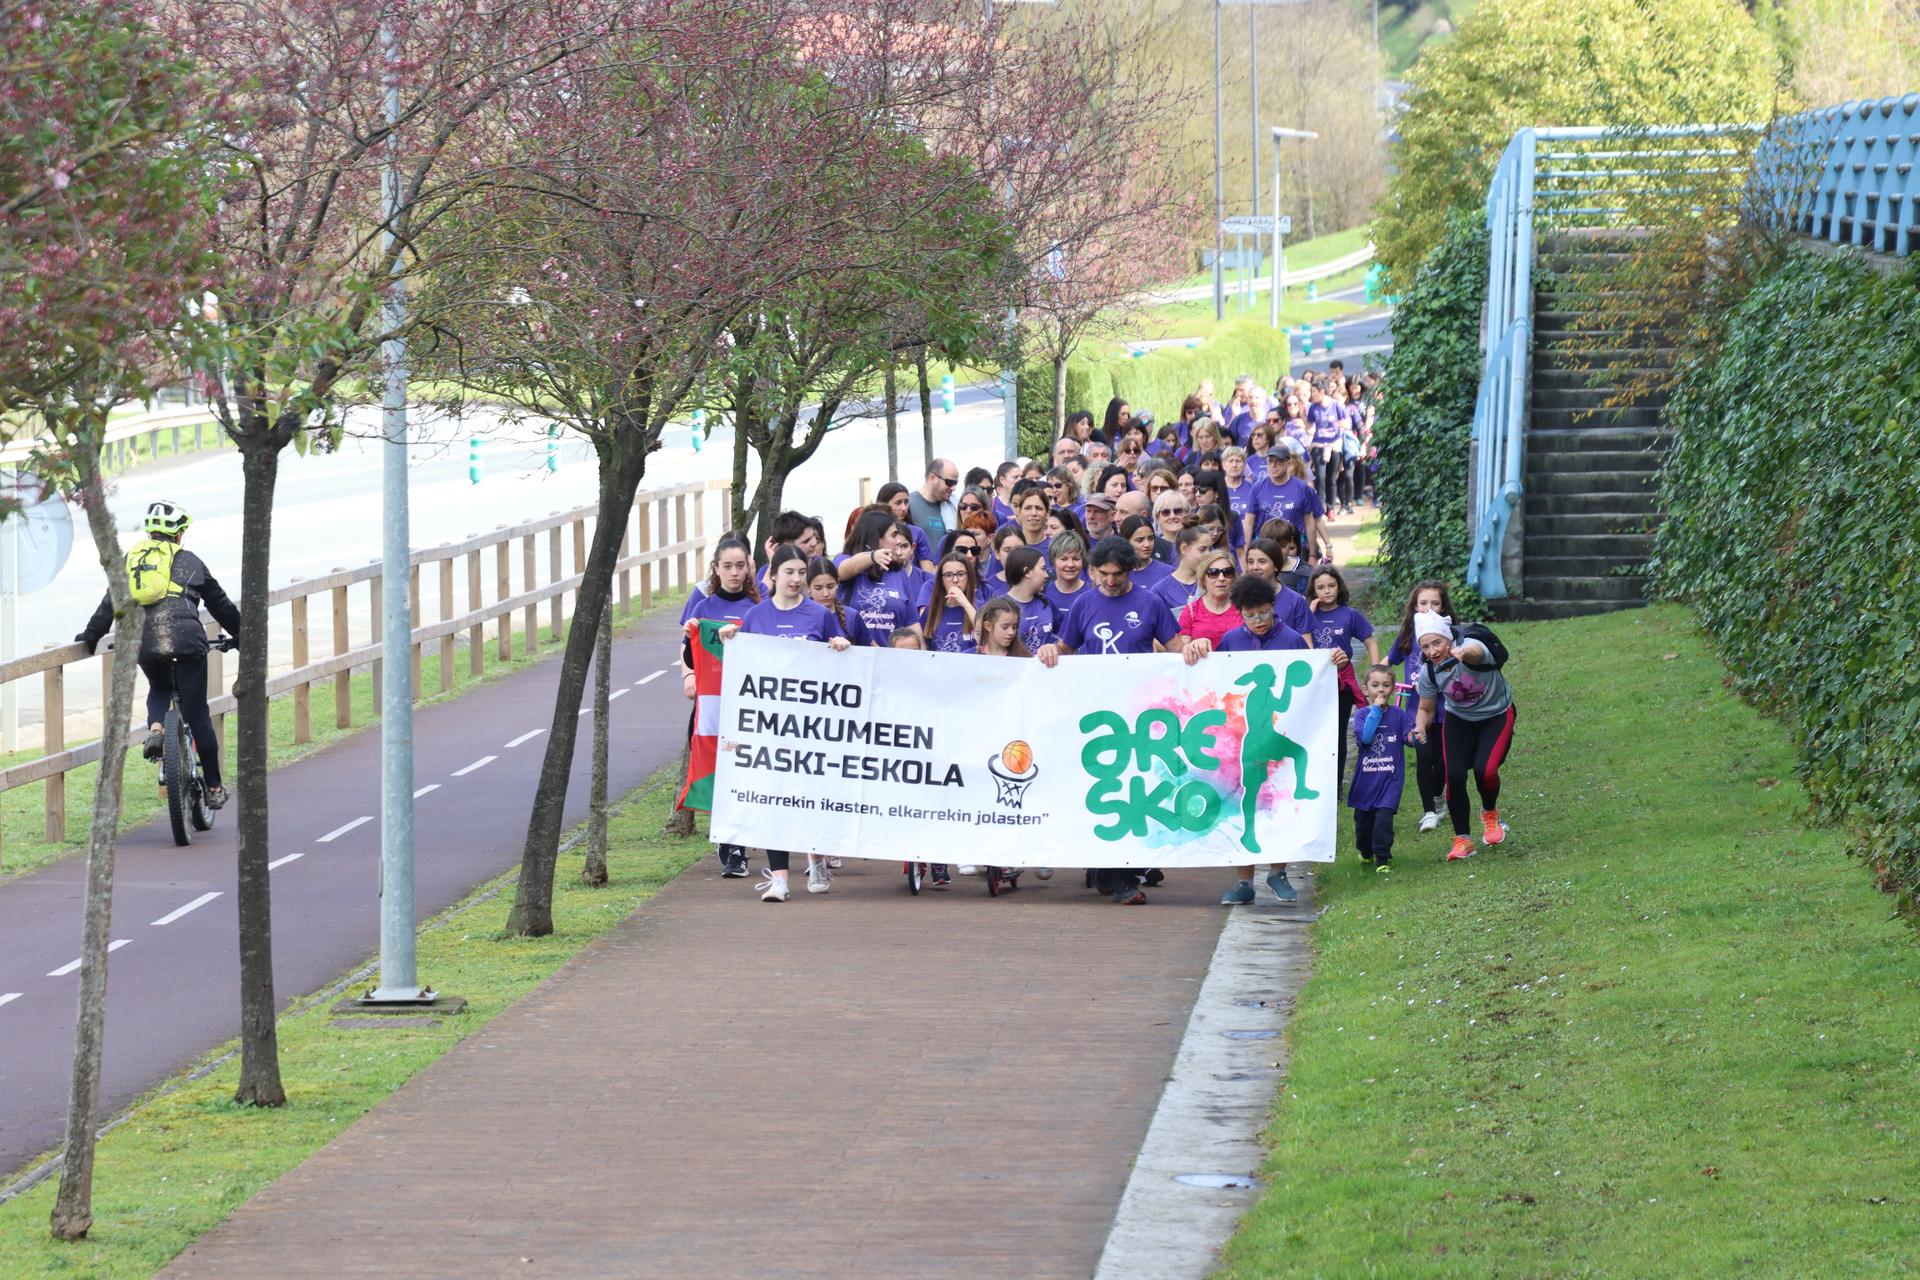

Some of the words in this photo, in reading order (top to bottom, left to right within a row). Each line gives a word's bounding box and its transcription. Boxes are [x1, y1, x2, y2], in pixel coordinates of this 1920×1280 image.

[738, 673, 862, 709] ARESKO
[738, 708, 934, 750] EMAKUMEEN
[734, 743, 965, 788] SASKI-ESKOLA
[820, 798, 883, 817] ikasten,
[888, 805, 972, 823] elkarrekin
